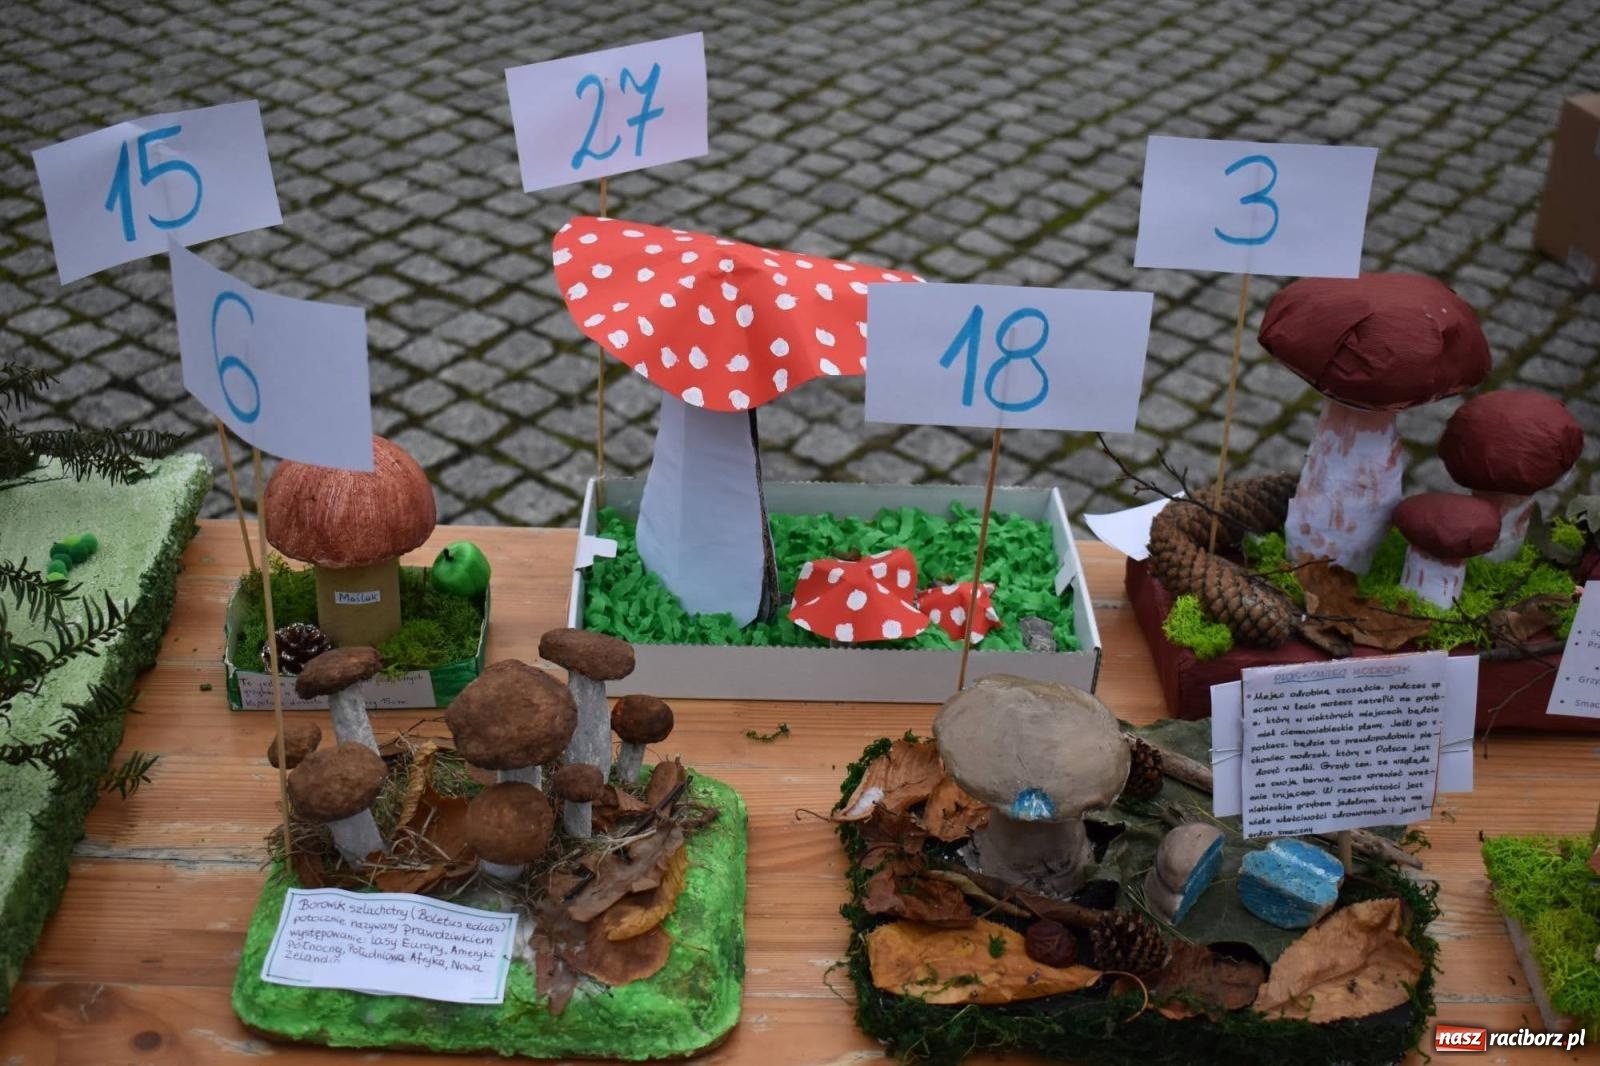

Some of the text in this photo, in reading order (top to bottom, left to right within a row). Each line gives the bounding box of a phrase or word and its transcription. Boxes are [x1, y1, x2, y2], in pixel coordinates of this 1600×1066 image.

[571, 62, 664, 170] 27
[104, 125, 203, 242] 15
[1214, 154, 1279, 246] 3
[212, 291, 260, 424] 6
[939, 304, 1049, 412] 18
[298, 898, 346, 911] Borowik
[349, 902, 408, 921] szlachetny
